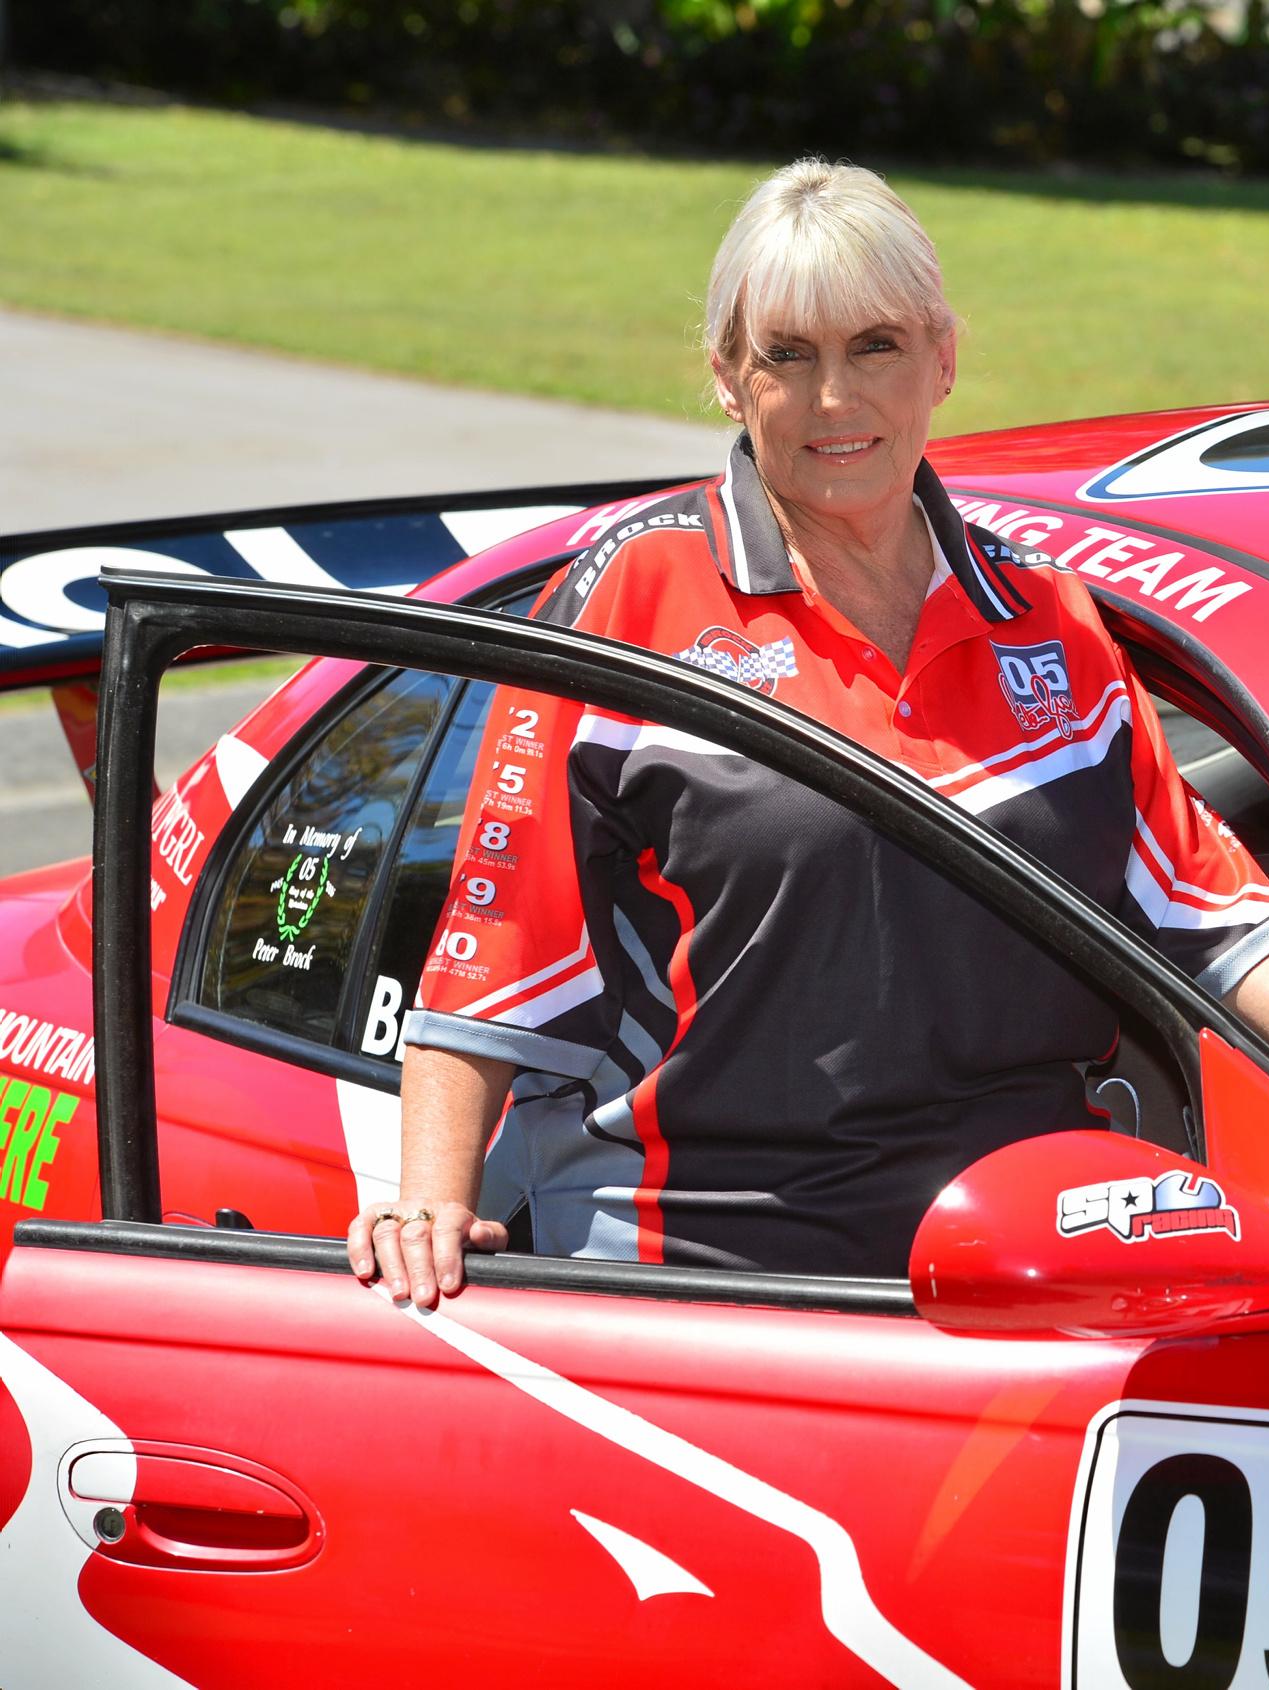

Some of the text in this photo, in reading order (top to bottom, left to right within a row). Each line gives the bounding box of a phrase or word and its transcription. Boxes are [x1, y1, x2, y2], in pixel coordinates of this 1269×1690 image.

[575, 513, 704, 598] BROCK
[1055, 527, 1253, 622] TEAM
[1000, 652, 1068, 696] 05
[283, 824, 362, 861] In Memory of
[299, 857, 319, 880] 05
[252, 937, 316, 970] Peter Brock
[0, 1076, 80, 1211] ERE
